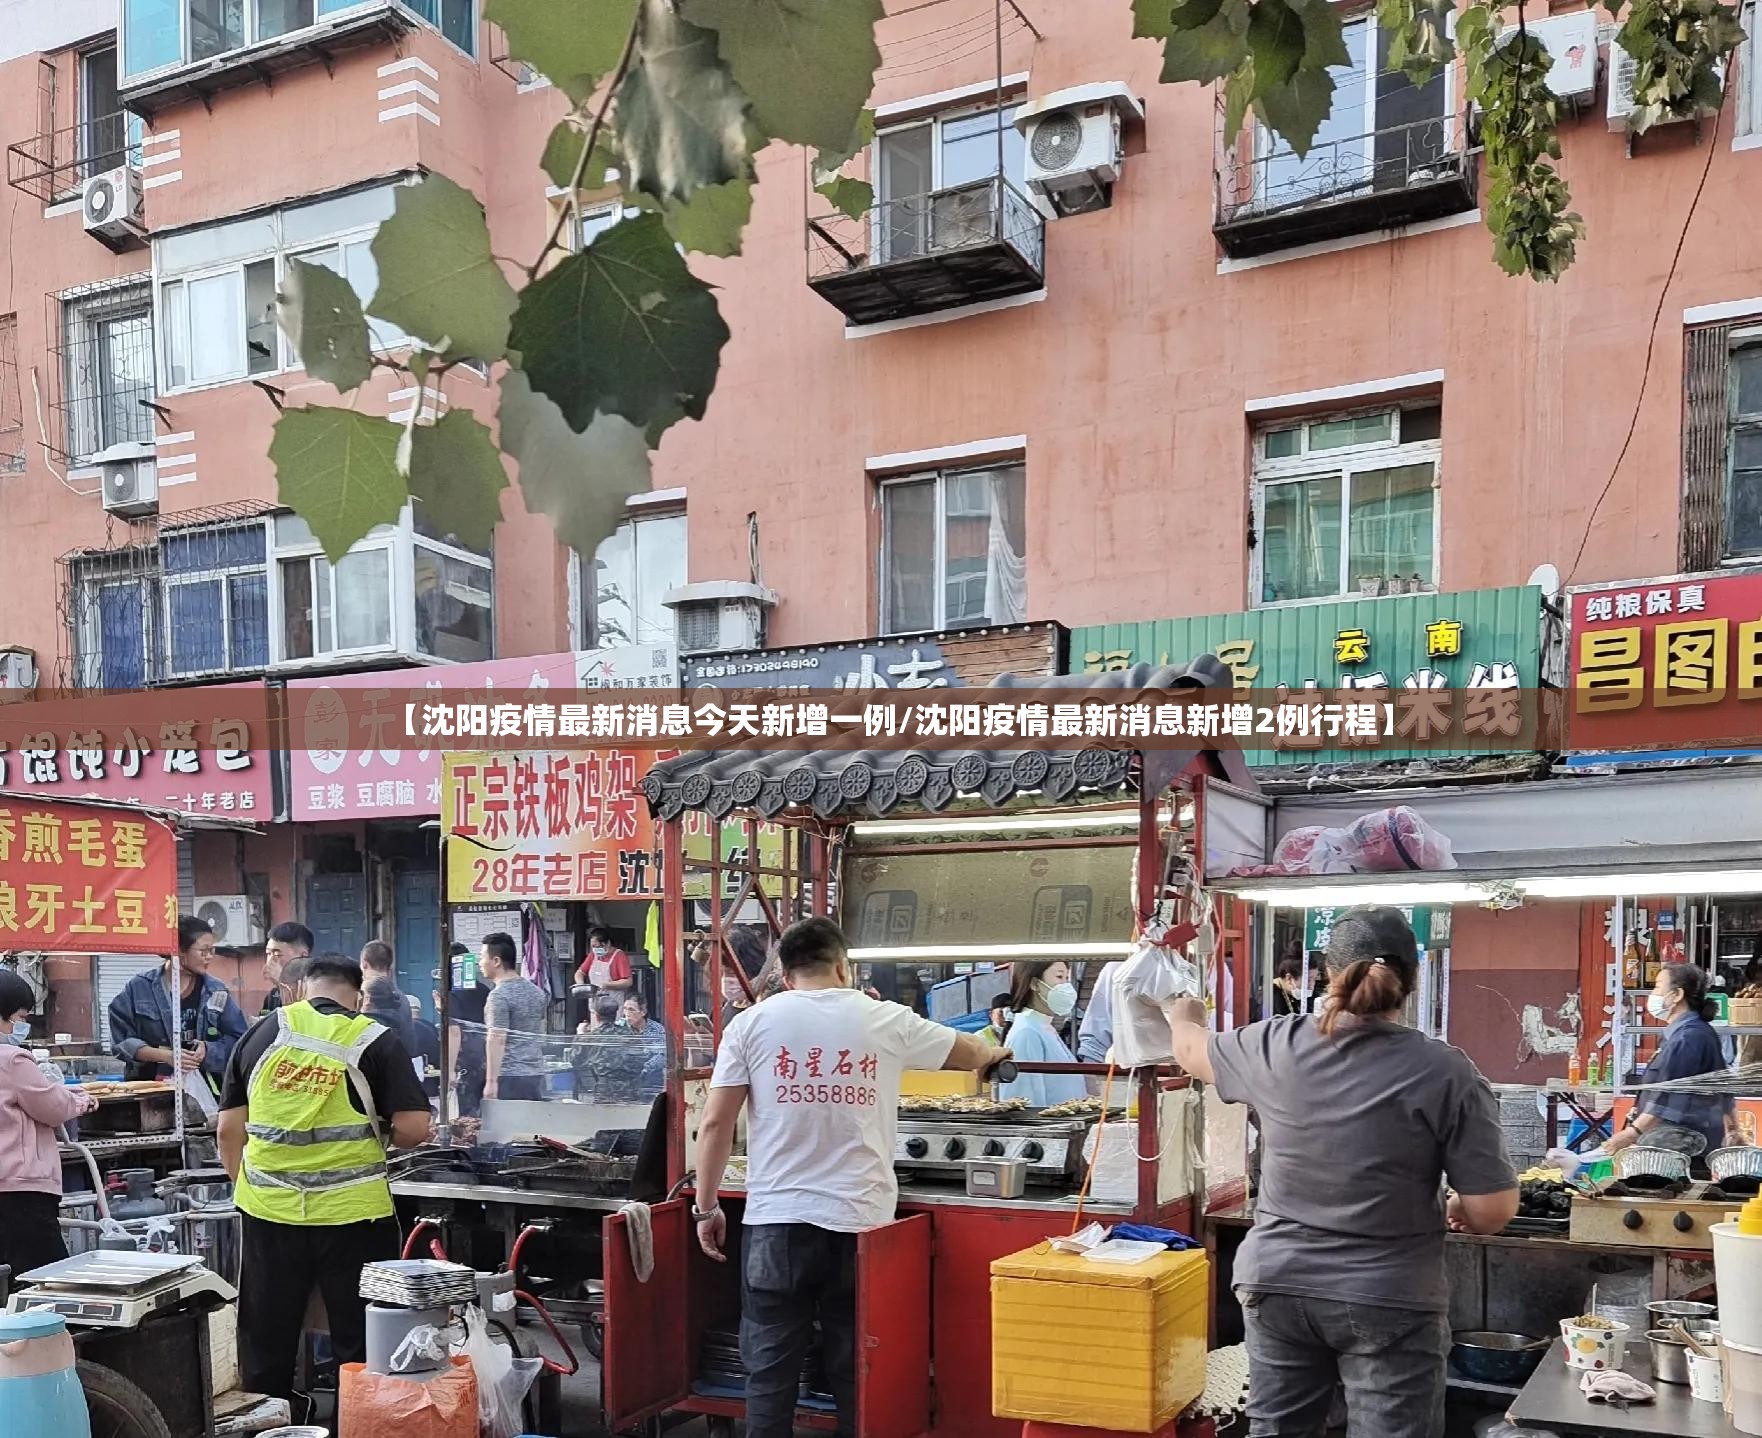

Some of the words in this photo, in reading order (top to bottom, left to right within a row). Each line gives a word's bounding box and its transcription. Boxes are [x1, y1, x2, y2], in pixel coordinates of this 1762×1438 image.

[1586, 584, 1705, 622] 纯粮保真
[1333, 620, 1463, 663] 云南
[0, 718, 251, 785] 馄饨小笼包
[308, 784, 345, 810] 豆浆
[357, 780, 415, 806] 豆腐脑
[450, 750, 637, 841] 正宗铁板鸡架
[472, 852, 608, 895] 28年老店
[773, 1045, 879, 1081] 南星石材
[775, 1084, 877, 1106] 25358886
